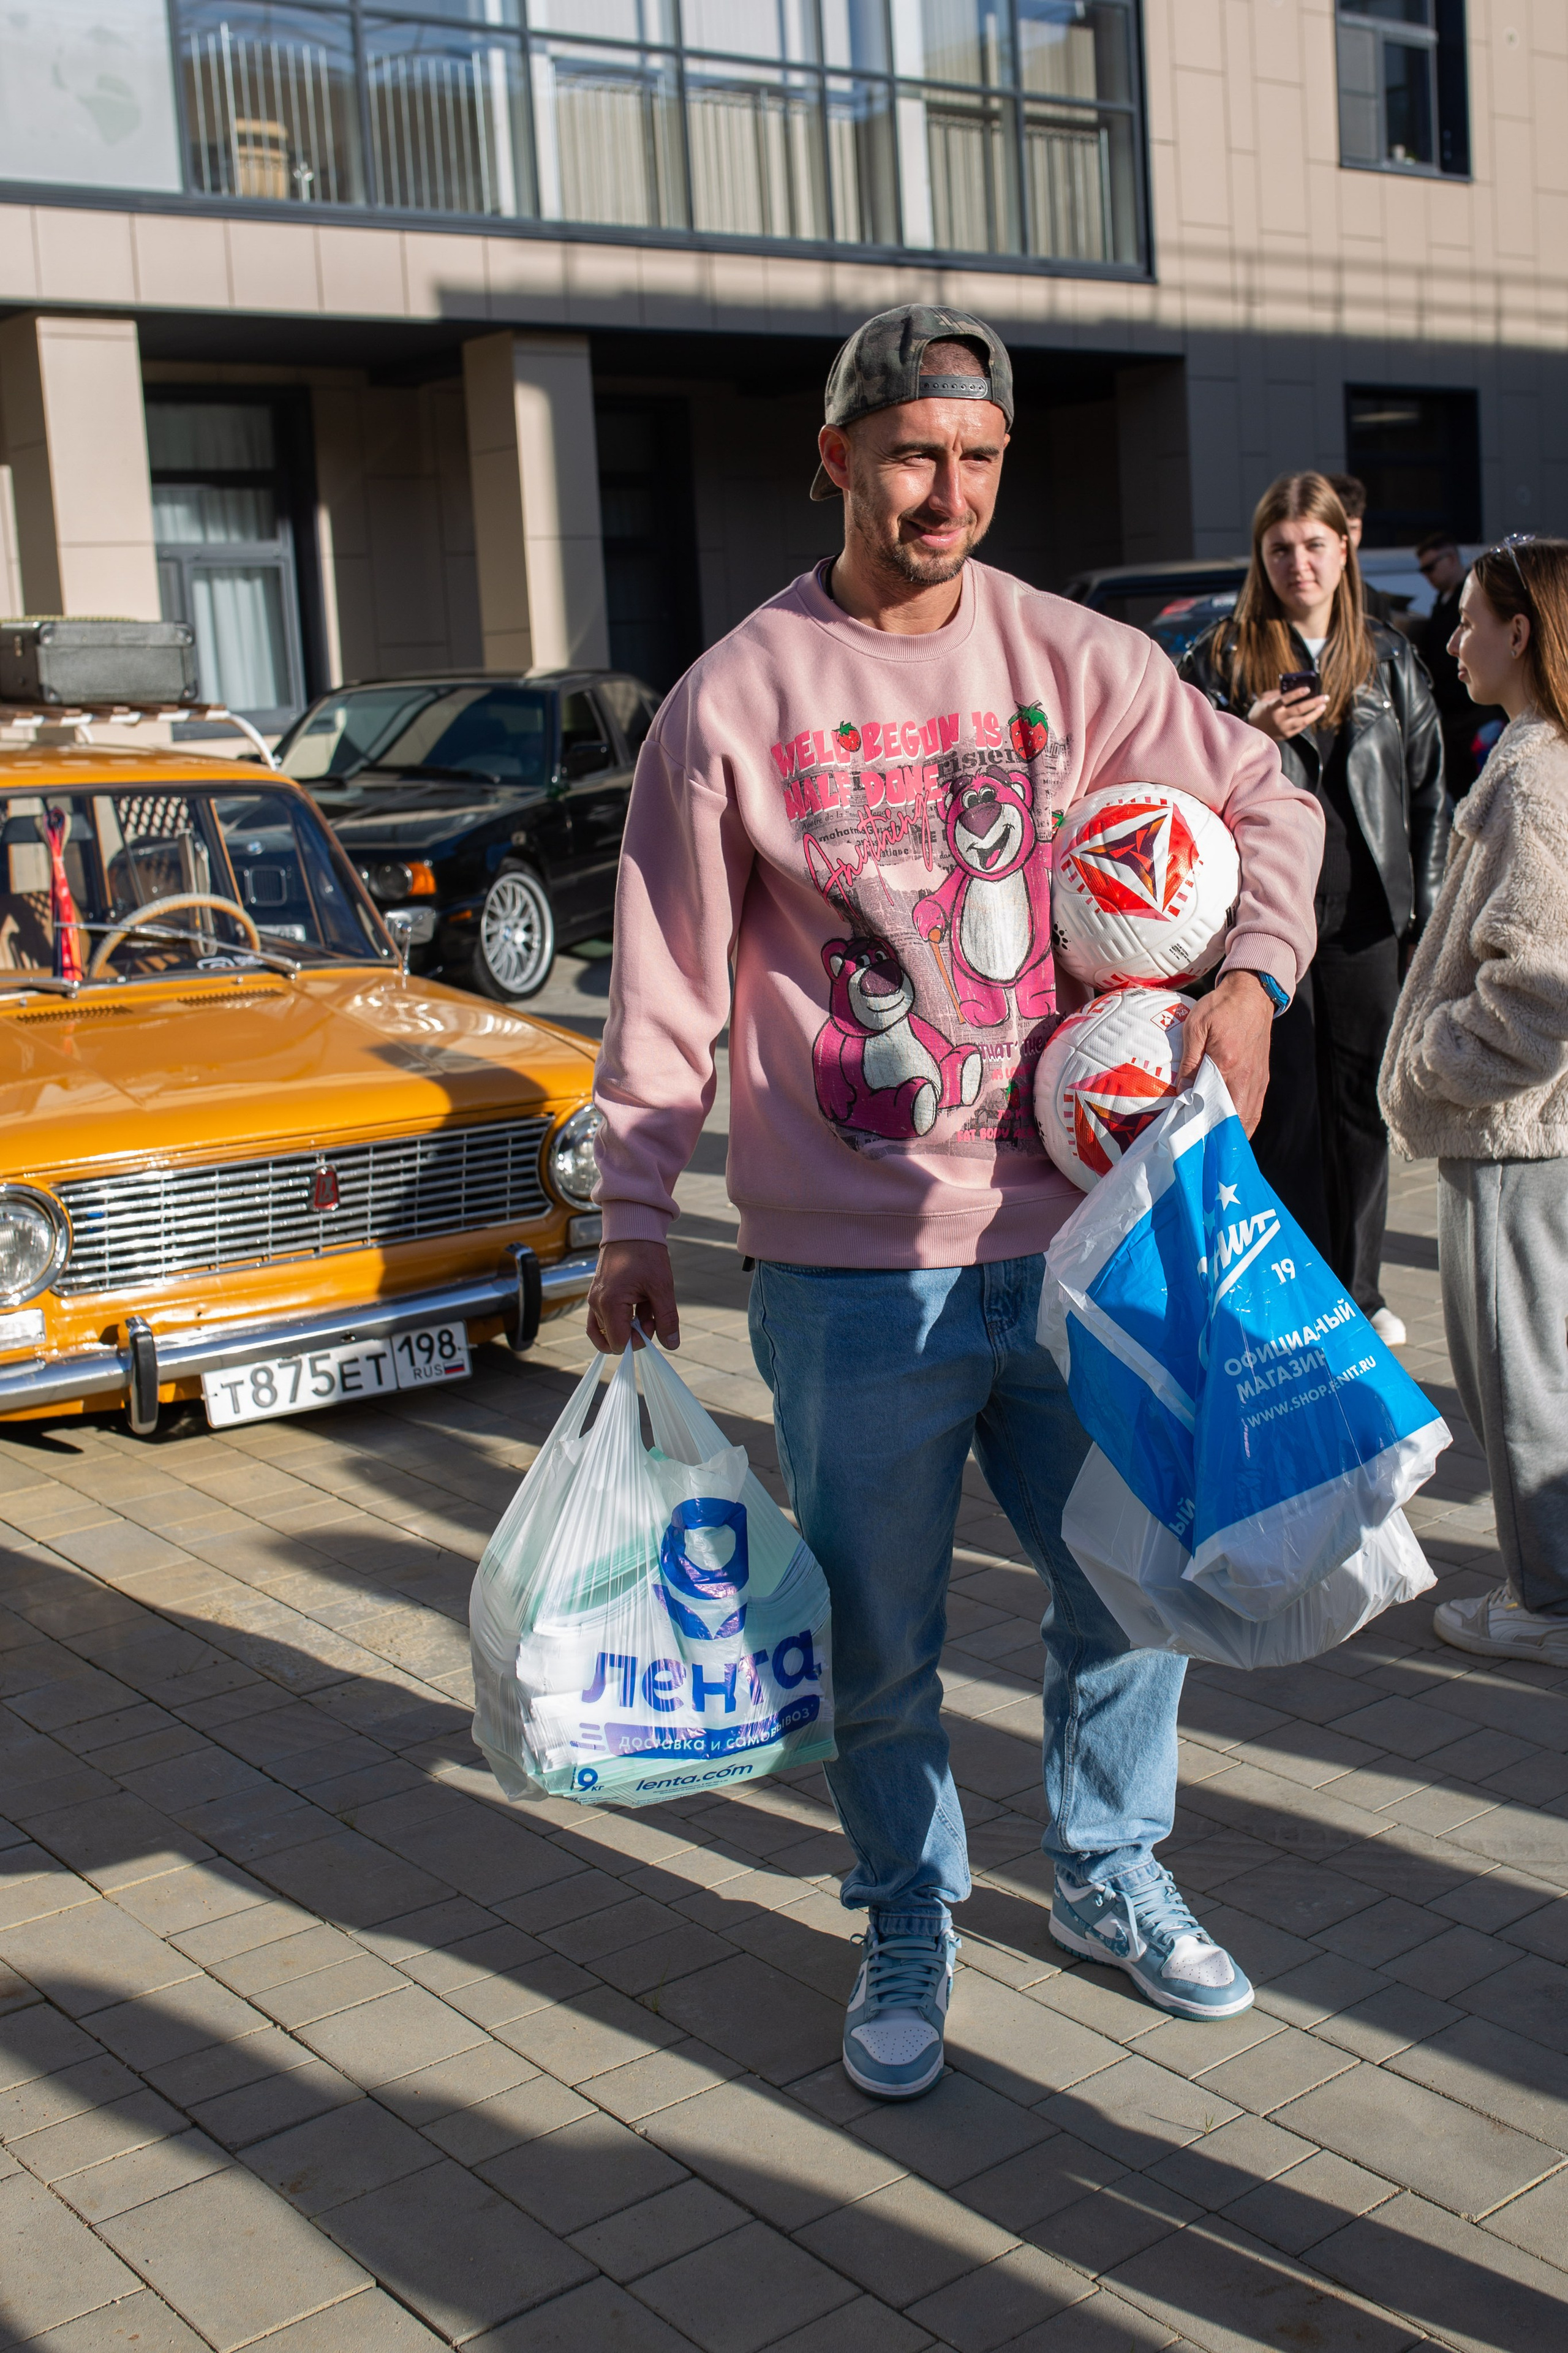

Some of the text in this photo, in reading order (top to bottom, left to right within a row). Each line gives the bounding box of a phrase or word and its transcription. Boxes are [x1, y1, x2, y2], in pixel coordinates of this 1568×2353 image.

[771, 711, 1003, 779] WELL BEGUN IS
[783, 763, 943, 823] HALF DONE
[1271, 1258, 1296, 1284] 19
[398, 1329, 454, 1367] 198
[413, 1364, 443, 1380] RUS
[619, 1735, 704, 1751] доставка
[710, 1740, 721, 1751] и
[577, 1767, 598, 1792] 9
[635, 1763, 753, 1791] lenta.com
